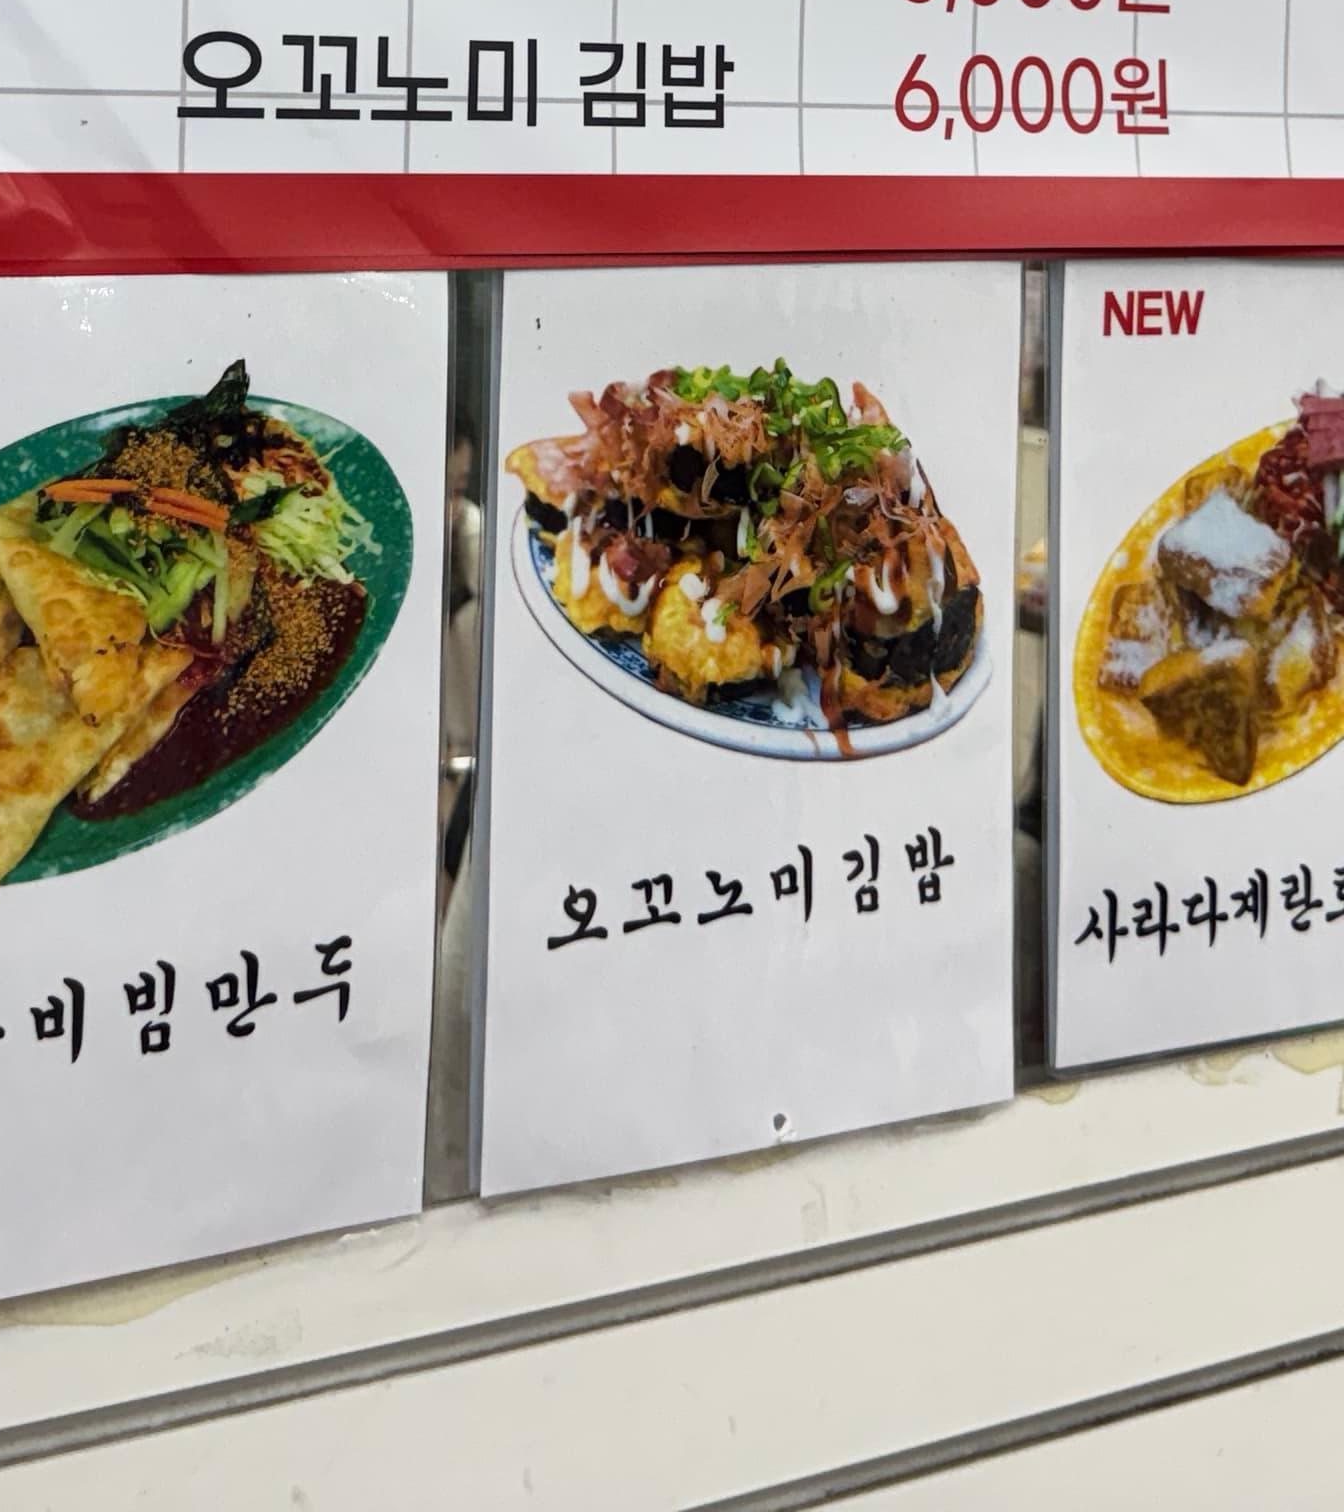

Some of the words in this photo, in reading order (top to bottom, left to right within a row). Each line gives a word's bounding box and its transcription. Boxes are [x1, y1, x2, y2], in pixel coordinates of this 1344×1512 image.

[176, 29, 541, 130] 오꼬노미
[576, 41, 736, 131] 김밥
[893, 53, 1171, 142] 6,000원
[1101, 289, 1205, 337] NEW
